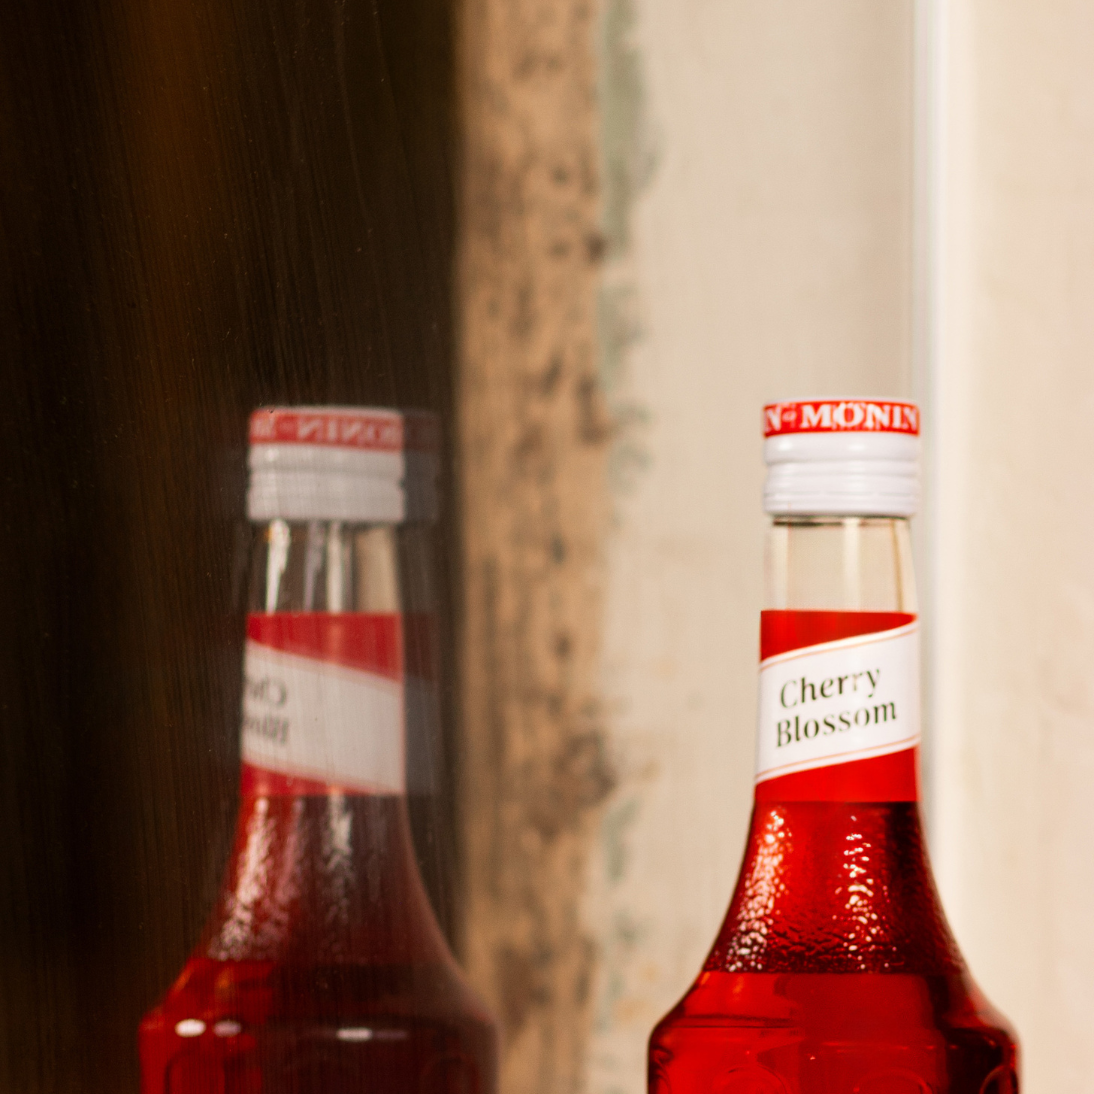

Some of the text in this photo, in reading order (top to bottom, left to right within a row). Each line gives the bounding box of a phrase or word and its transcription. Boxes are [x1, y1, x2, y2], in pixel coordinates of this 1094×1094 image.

[800, 401, 918, 431] MONIN
[780, 668, 880, 709] Cherry
[776, 701, 897, 748] Blossom
